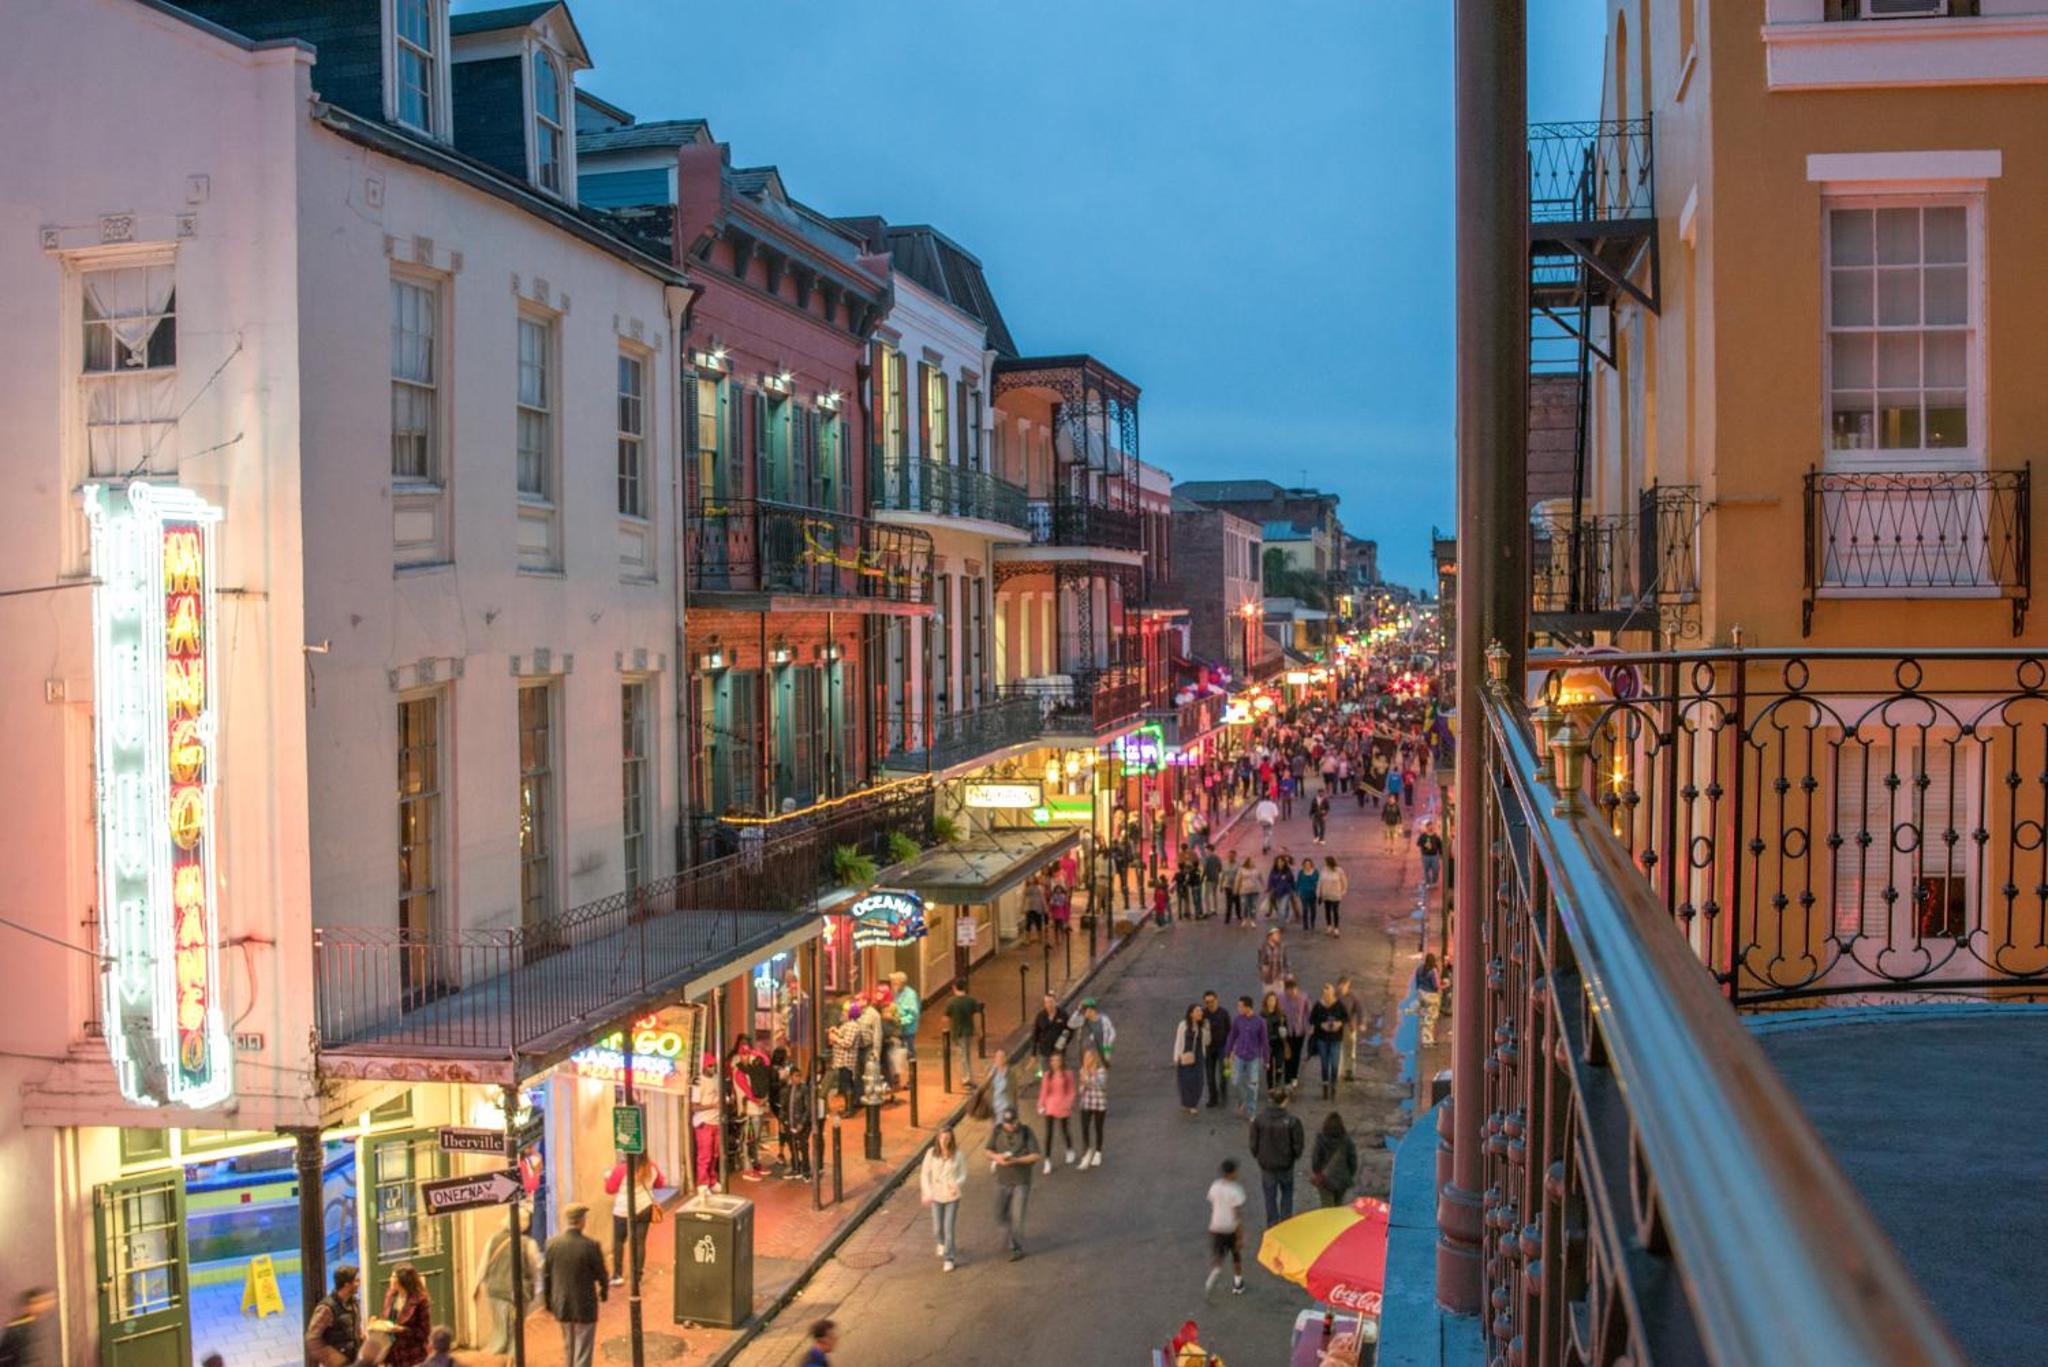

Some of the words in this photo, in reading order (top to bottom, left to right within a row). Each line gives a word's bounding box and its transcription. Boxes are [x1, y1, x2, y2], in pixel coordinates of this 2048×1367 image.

[164, 530, 204, 849] MANGO
[852, 895, 913, 920] OCEANA
[444, 1134, 502, 1149] Iberville
